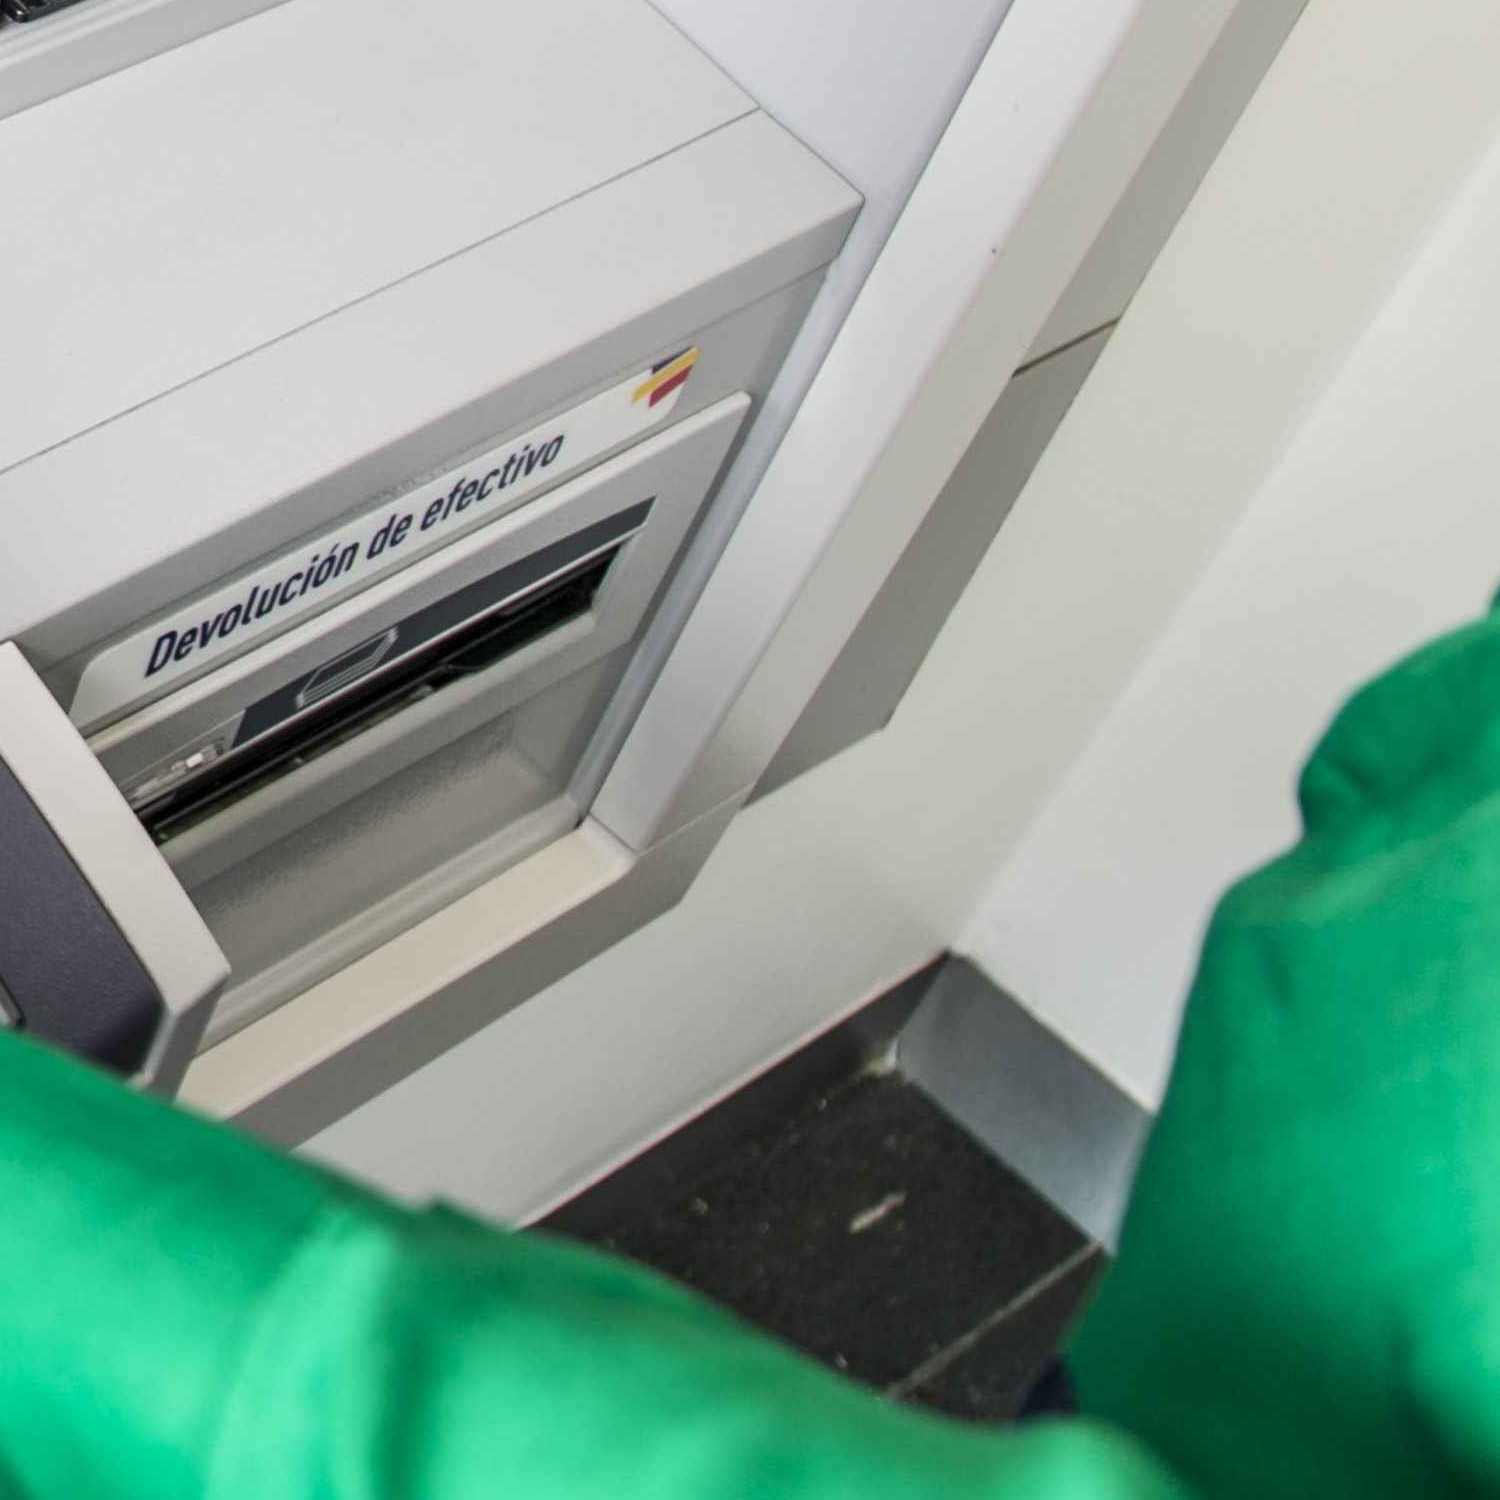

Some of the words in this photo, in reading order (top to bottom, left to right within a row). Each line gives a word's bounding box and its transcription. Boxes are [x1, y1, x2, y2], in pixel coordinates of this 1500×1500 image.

[144, 540, 359, 679] Devolución
[364, 512, 415, 561] de
[419, 432, 567, 534] efectivo
